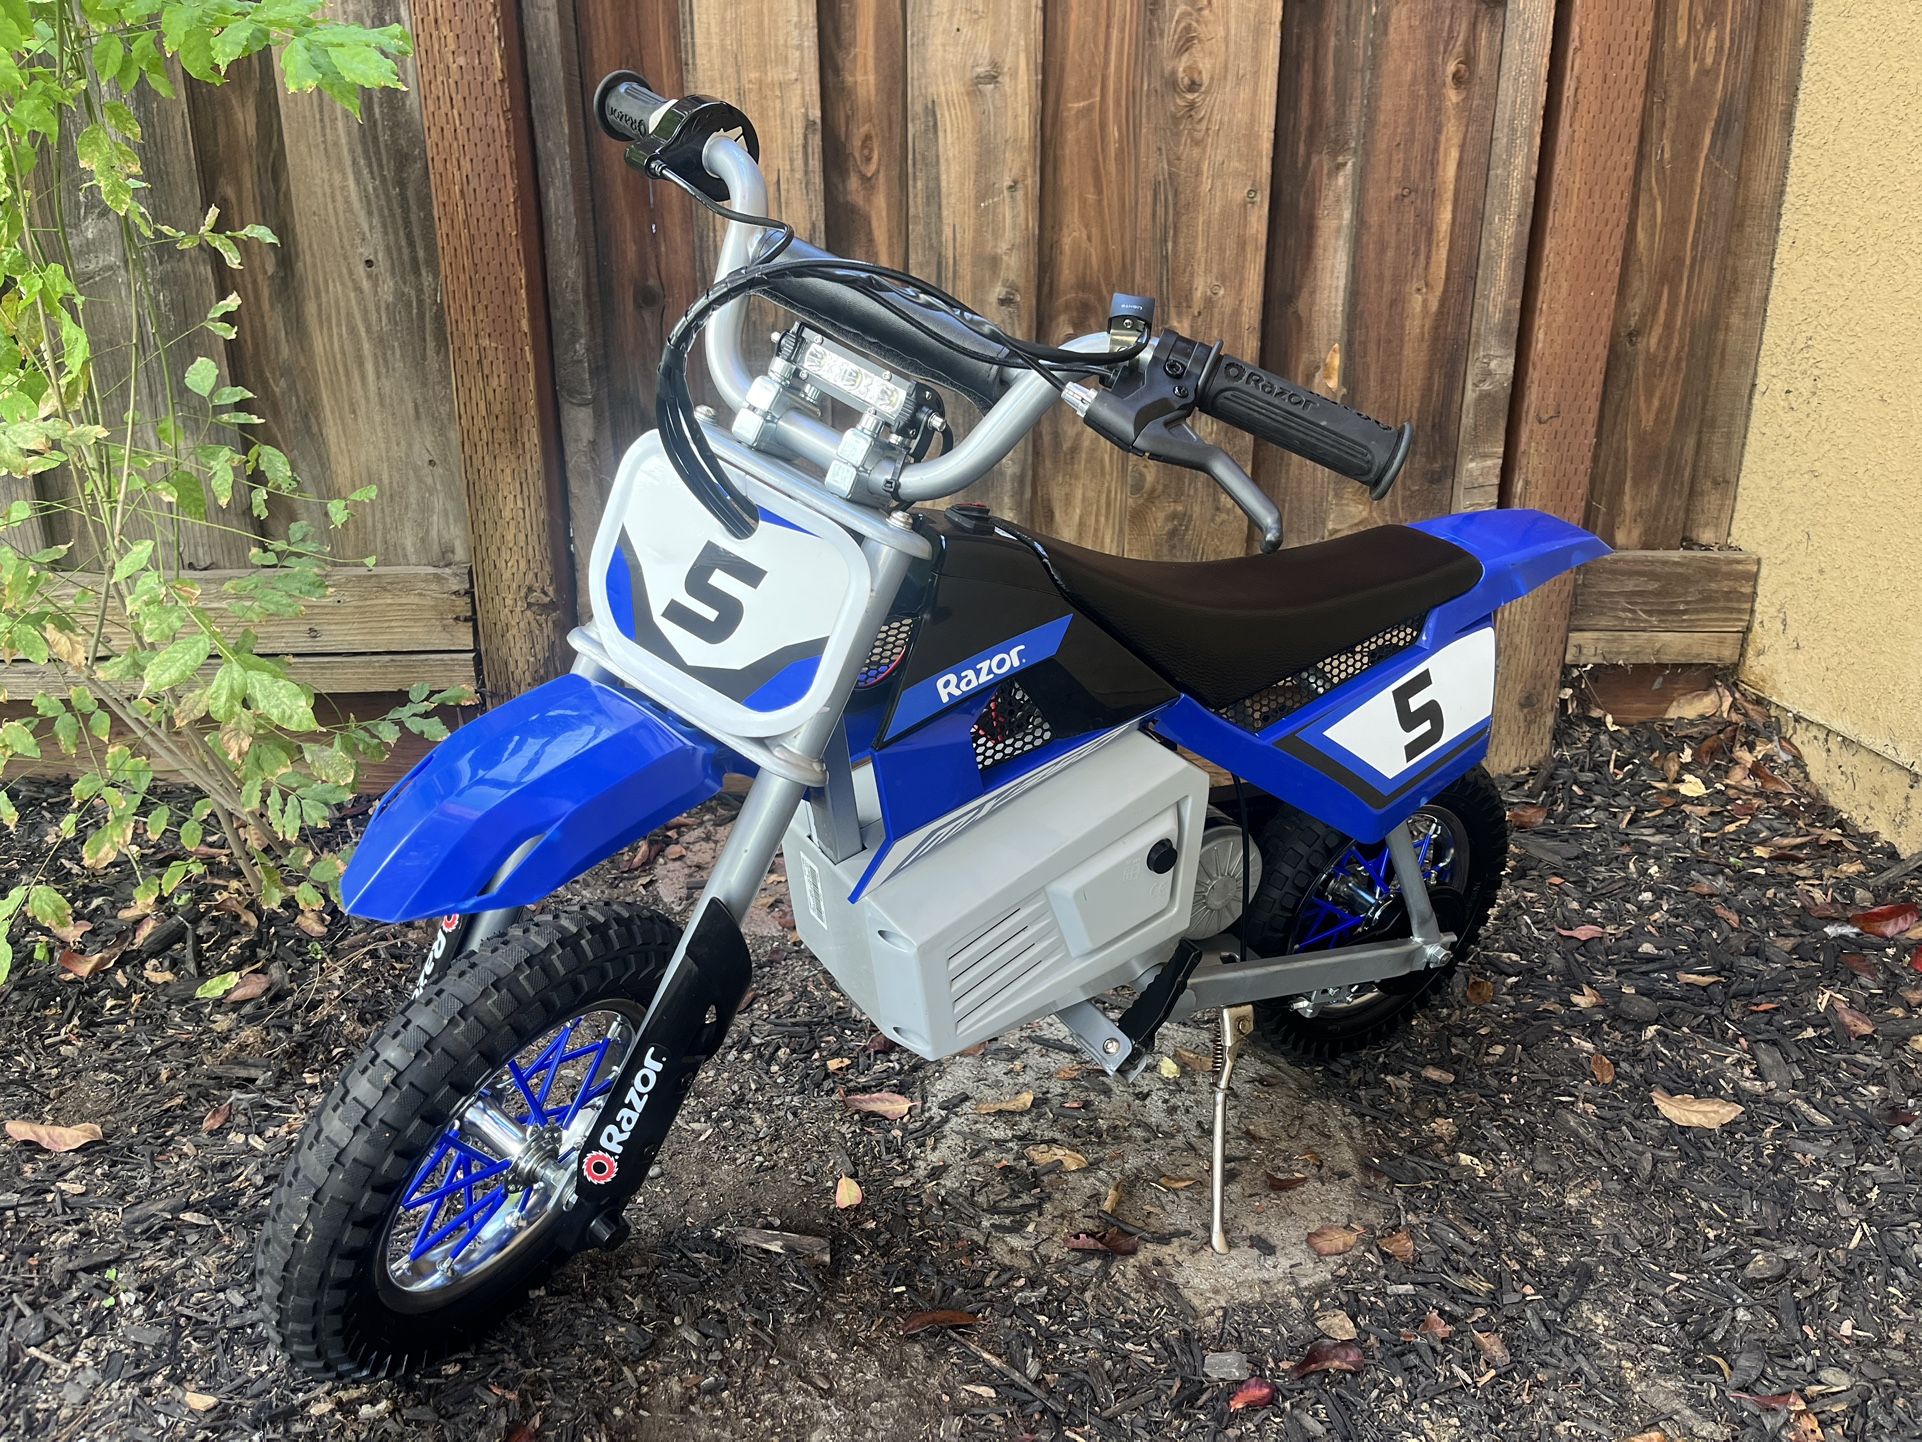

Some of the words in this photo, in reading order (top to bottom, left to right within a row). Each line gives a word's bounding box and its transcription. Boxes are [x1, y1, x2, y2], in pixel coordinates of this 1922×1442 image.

[1245, 371, 1317, 411] Razor
[661, 540, 768, 645] 5
[936, 645, 1026, 704] Razor
[1392, 668, 1445, 764] 5
[600, 1046, 664, 1154] Razor
